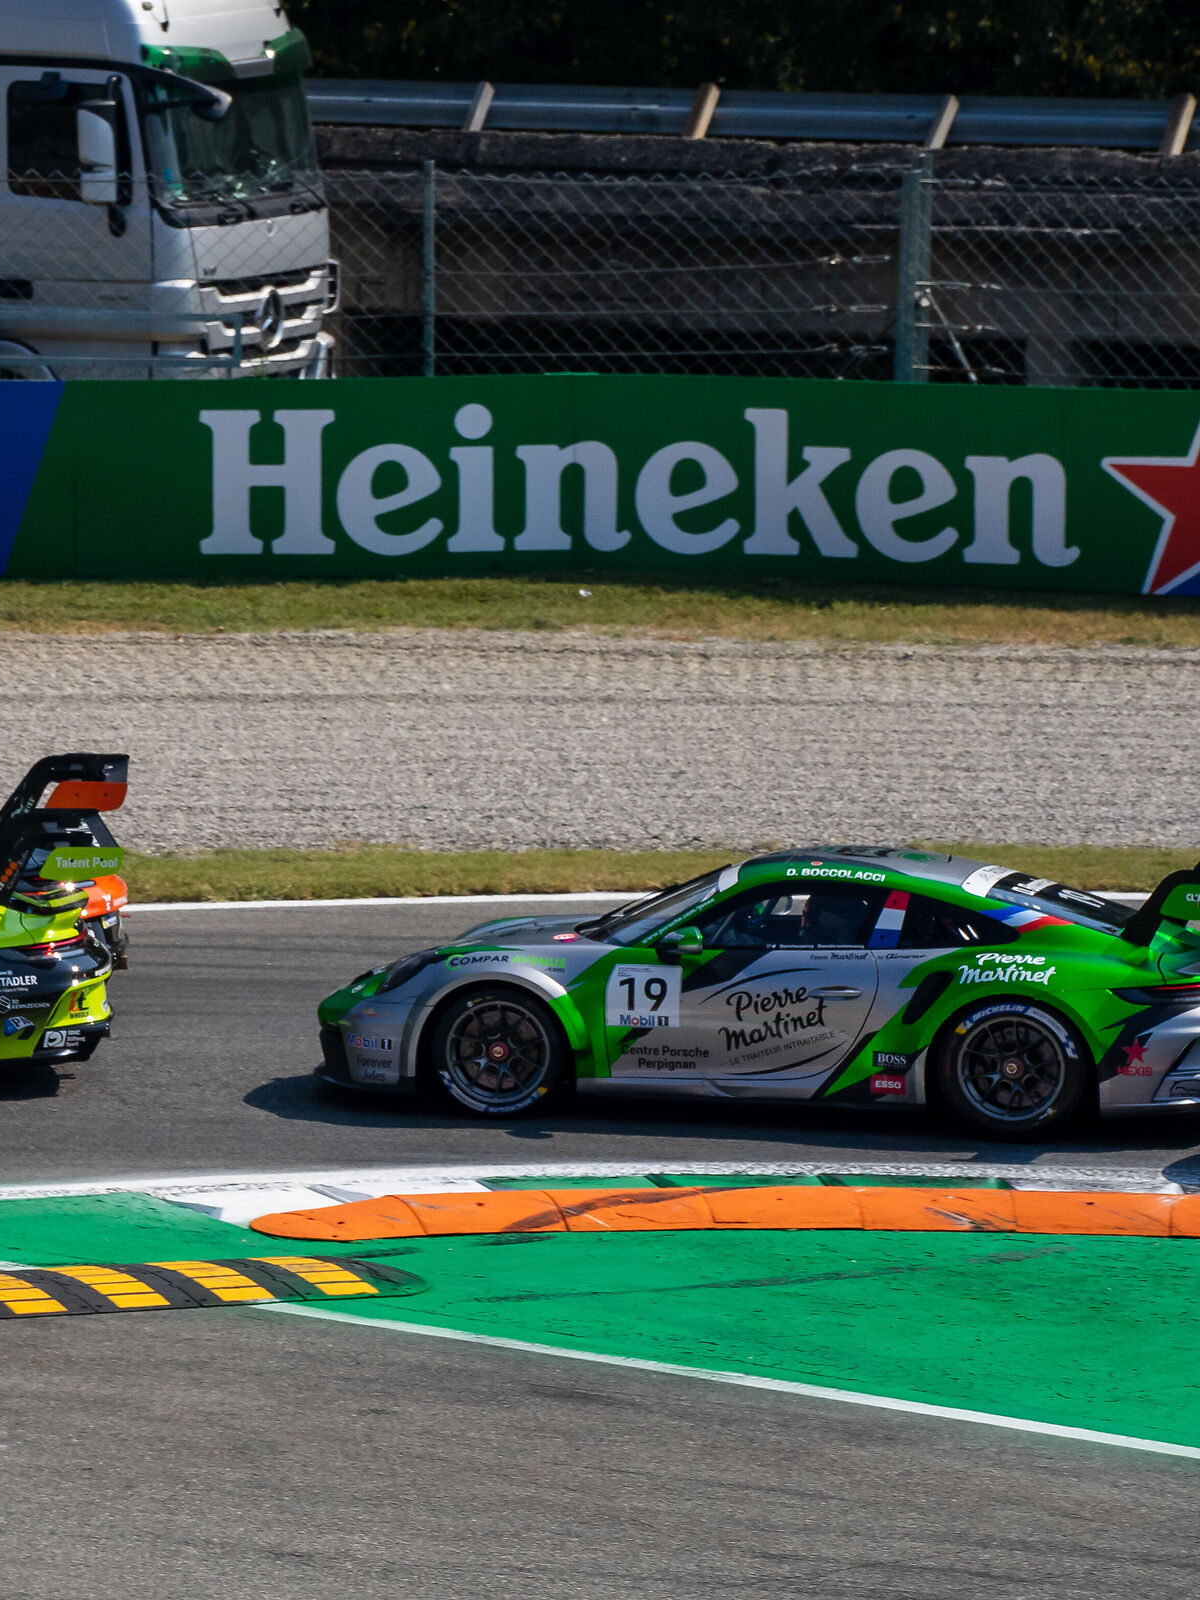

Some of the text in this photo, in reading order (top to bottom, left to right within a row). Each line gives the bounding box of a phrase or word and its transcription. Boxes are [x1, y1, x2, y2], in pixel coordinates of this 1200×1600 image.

[199, 403, 1081, 566] Heineken
[55, 857, 118, 869] Talent Pool
[786, 868, 886, 882] D. BOCCOLACCI
[445, 954, 567, 971] COMPAR AVENUE
[975, 953, 1046, 966] Pierre
[958, 965, 1056, 985] Martinet
[619, 978, 668, 1012] 19
[726, 985, 810, 1022] Pierre
[973, 1003, 1026, 1022] MICHELIN
[620, 1014, 669, 1027] Mobil 1
[718, 999, 828, 1052] Martinet
[348, 1034, 377, 1049] Mobil
[730, 1031, 836, 1065] LE TRAITEUR INTRAITABLE
[621, 1044, 710, 1058] Centre Porsche
[877, 1053, 907, 1064] BOSS
[638, 1058, 696, 1071] Perpignan
[875, 1080, 901, 1089] ESSO
